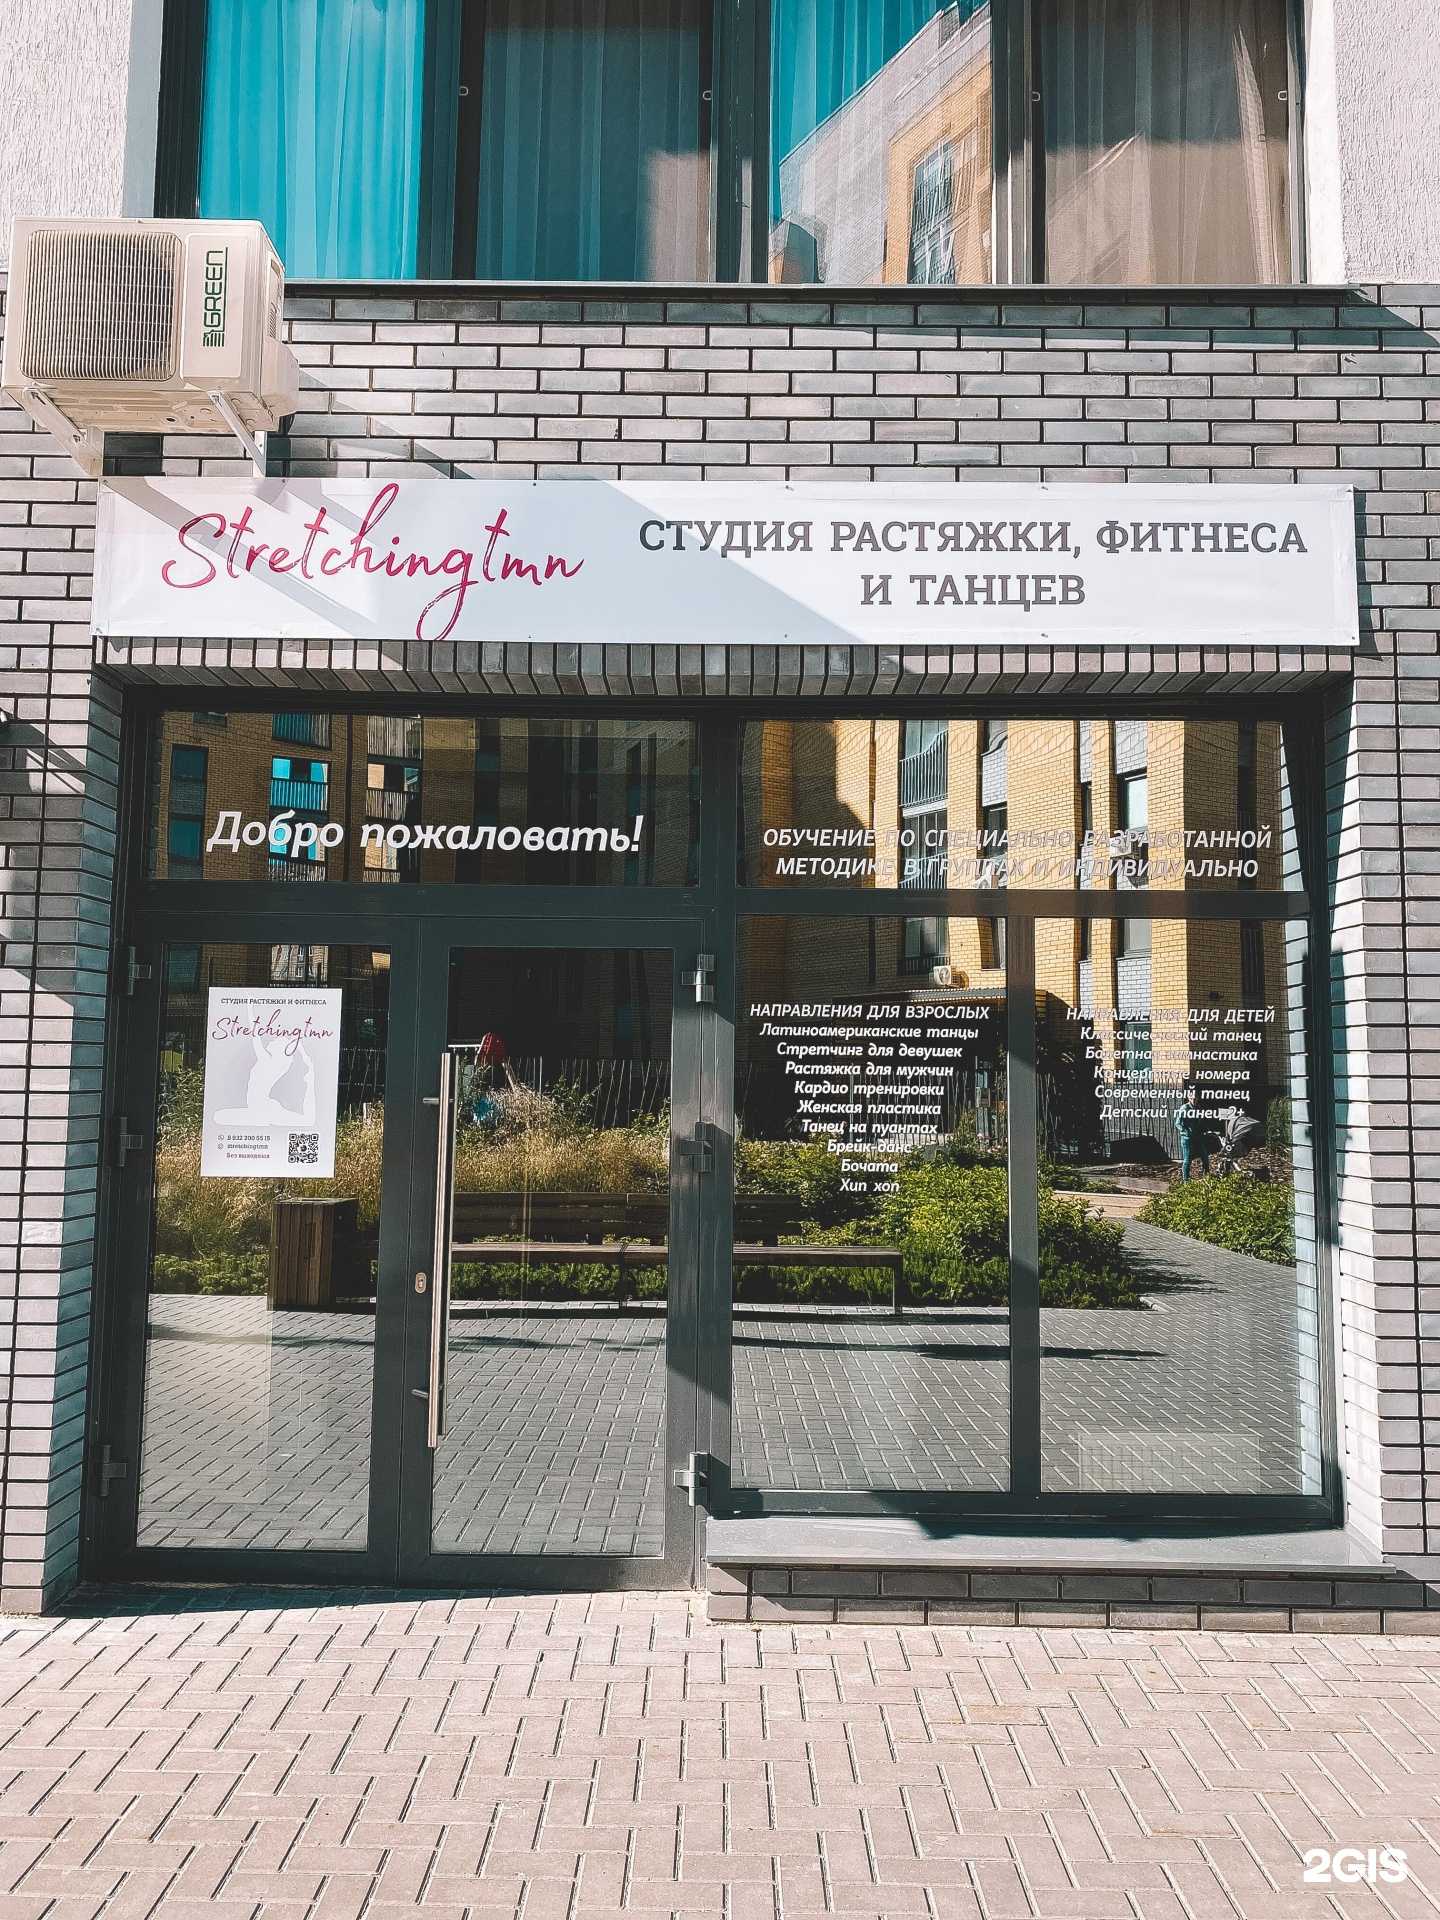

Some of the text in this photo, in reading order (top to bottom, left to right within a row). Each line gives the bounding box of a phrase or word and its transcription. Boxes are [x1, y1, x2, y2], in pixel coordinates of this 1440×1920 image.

[203, 249, 224, 329] GREEN
[639, 520, 1307, 559] СТУДИЯ РАСТЯЖКИ, ФИТНЕСА
[161, 482, 584, 640] Stretchingtmn
[860, 575, 1086, 612] И ТАНЦЕВ
[206, 809, 645, 858] Добро пожаловать!
[763, 828, 876, 847] ОБУЧЕНИЕ
[750, 1003, 990, 1020] НАПРАВЛЕНИЯ ДЛЯ ВЗРОСЛЫХ
[1187, 1009, 1220, 1024] ДЛЯ
[1224, 1006, 1275, 1024] ДЕТЕЙ
[212, 1008, 333, 1056] Stretchingtmn
[759, 1023, 979, 1040] Латиноамериканские танцы
[1212, 1031, 1262, 1044] танец
[777, 1042, 963, 1059] Стретчинг для девушек
[785, 1061, 954, 1079] Растяжка для мужчин
[1195, 1070, 1250, 1082] номера
[794, 1080, 945, 1097] Кардио тренировки
[1095, 1085, 1250, 1102] Современный танец
[796, 1100, 941, 1115] Женская пластика
[1099, 1104, 1168, 1120] Детский
[801, 1119, 938, 1136] Танец на пуантах
[827, 1139, 913, 1155] Брейк-данс
[841, 1159, 899, 1172] Бочата
[840, 1178, 900, 1194] Хип хоп
